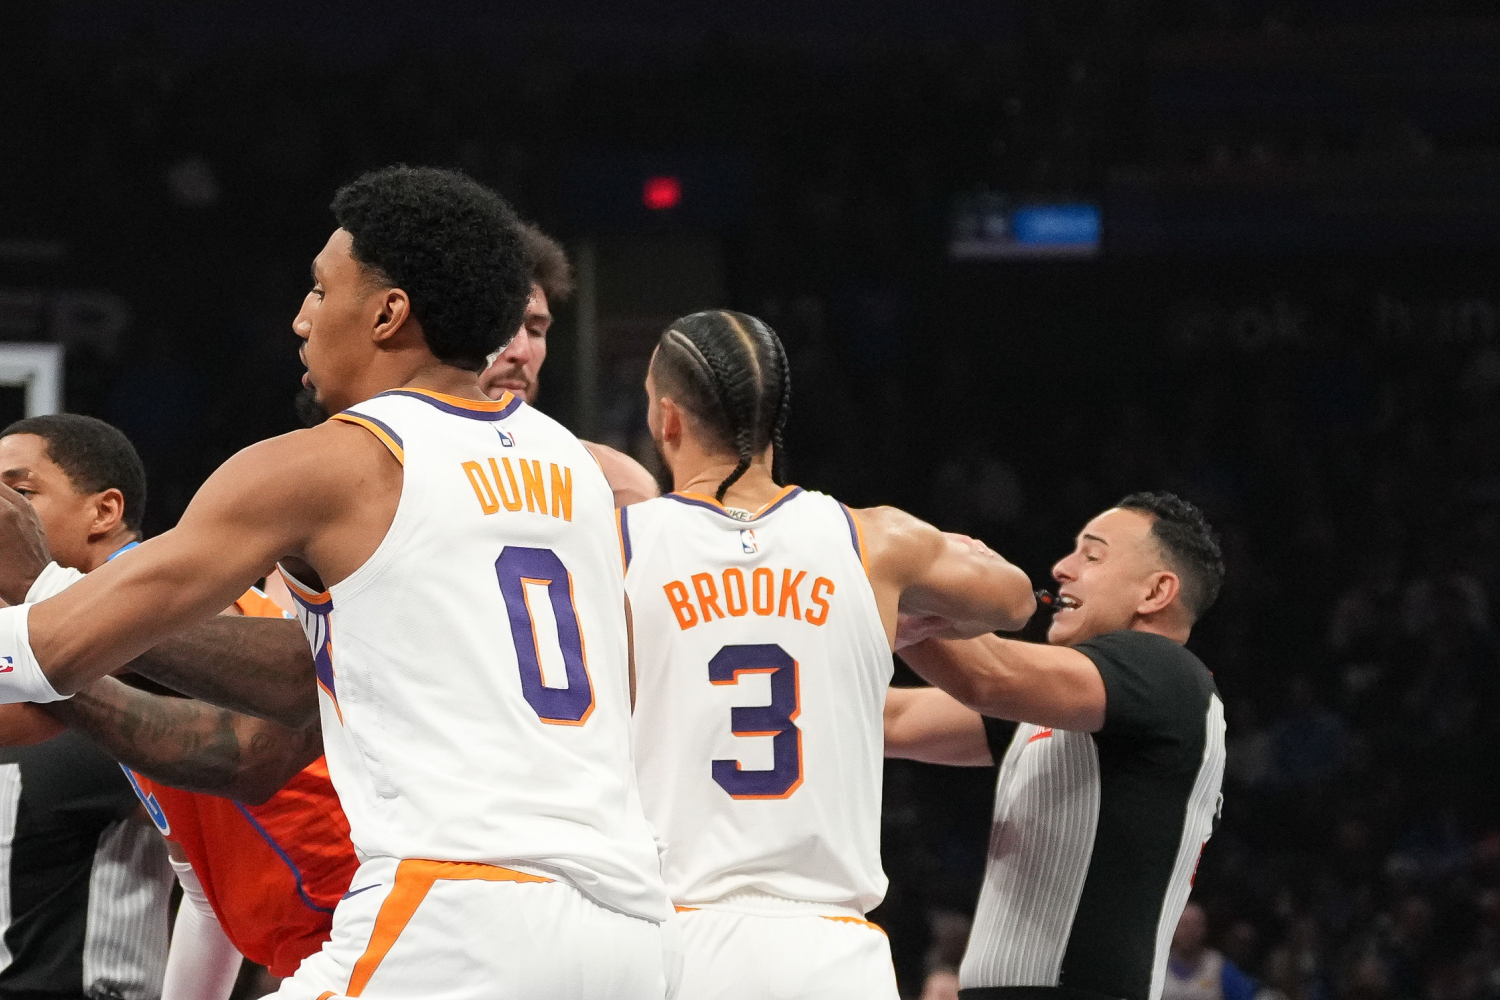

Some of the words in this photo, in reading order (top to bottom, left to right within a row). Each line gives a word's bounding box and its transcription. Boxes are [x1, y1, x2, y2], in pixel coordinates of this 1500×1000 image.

[461, 456, 572, 522] DUNN
[494, 545, 596, 727] 0
[663, 567, 836, 631] BROOKS
[708, 643, 804, 800] 3
